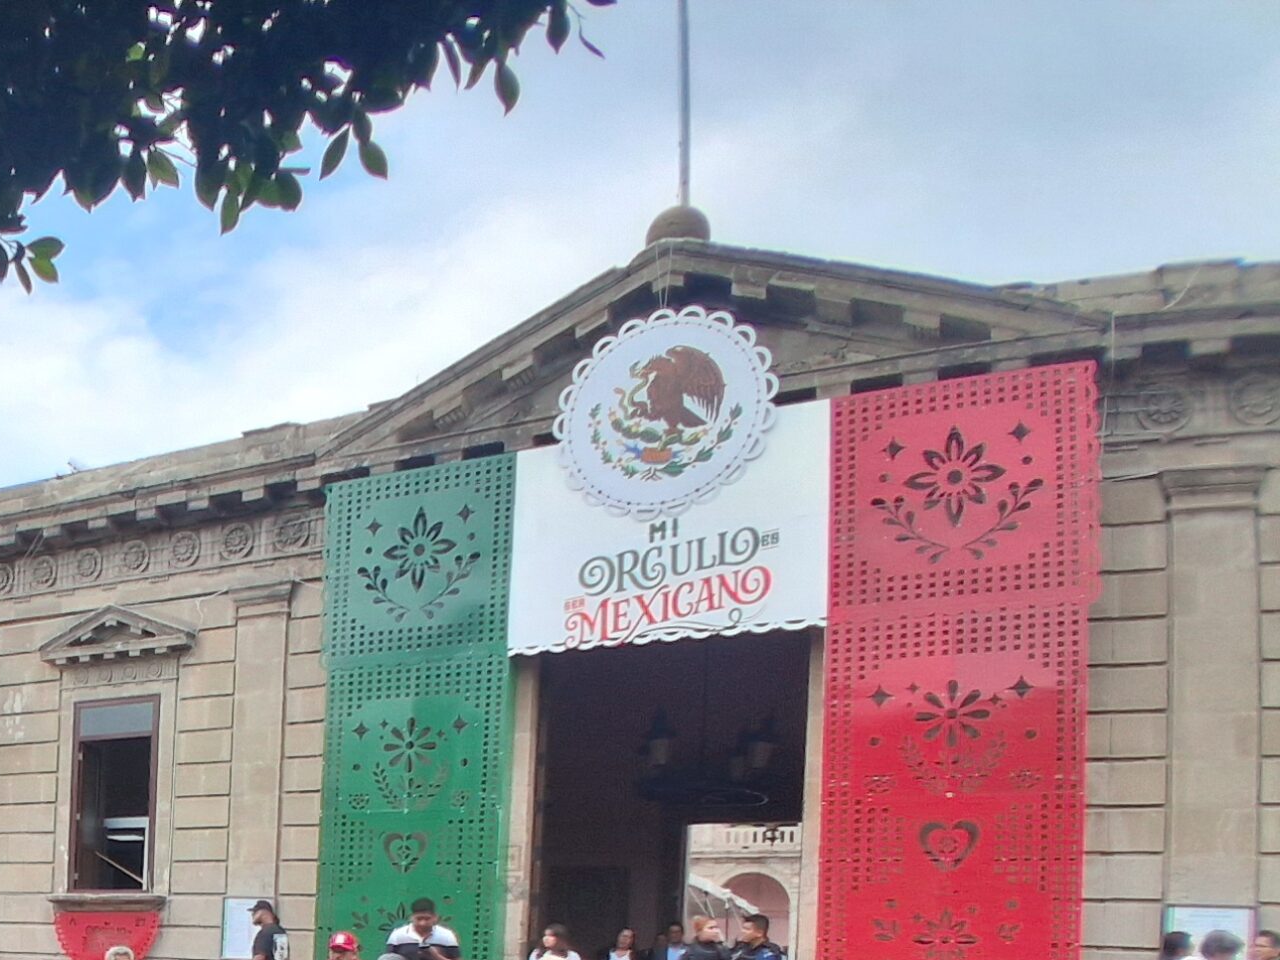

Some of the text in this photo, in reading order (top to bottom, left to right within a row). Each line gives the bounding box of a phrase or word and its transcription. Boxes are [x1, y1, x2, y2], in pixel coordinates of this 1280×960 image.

[578, 526, 780, 597] ORGULLO ES
[648, 517, 679, 544] MI
[564, 565, 773, 648] MEXICANO
